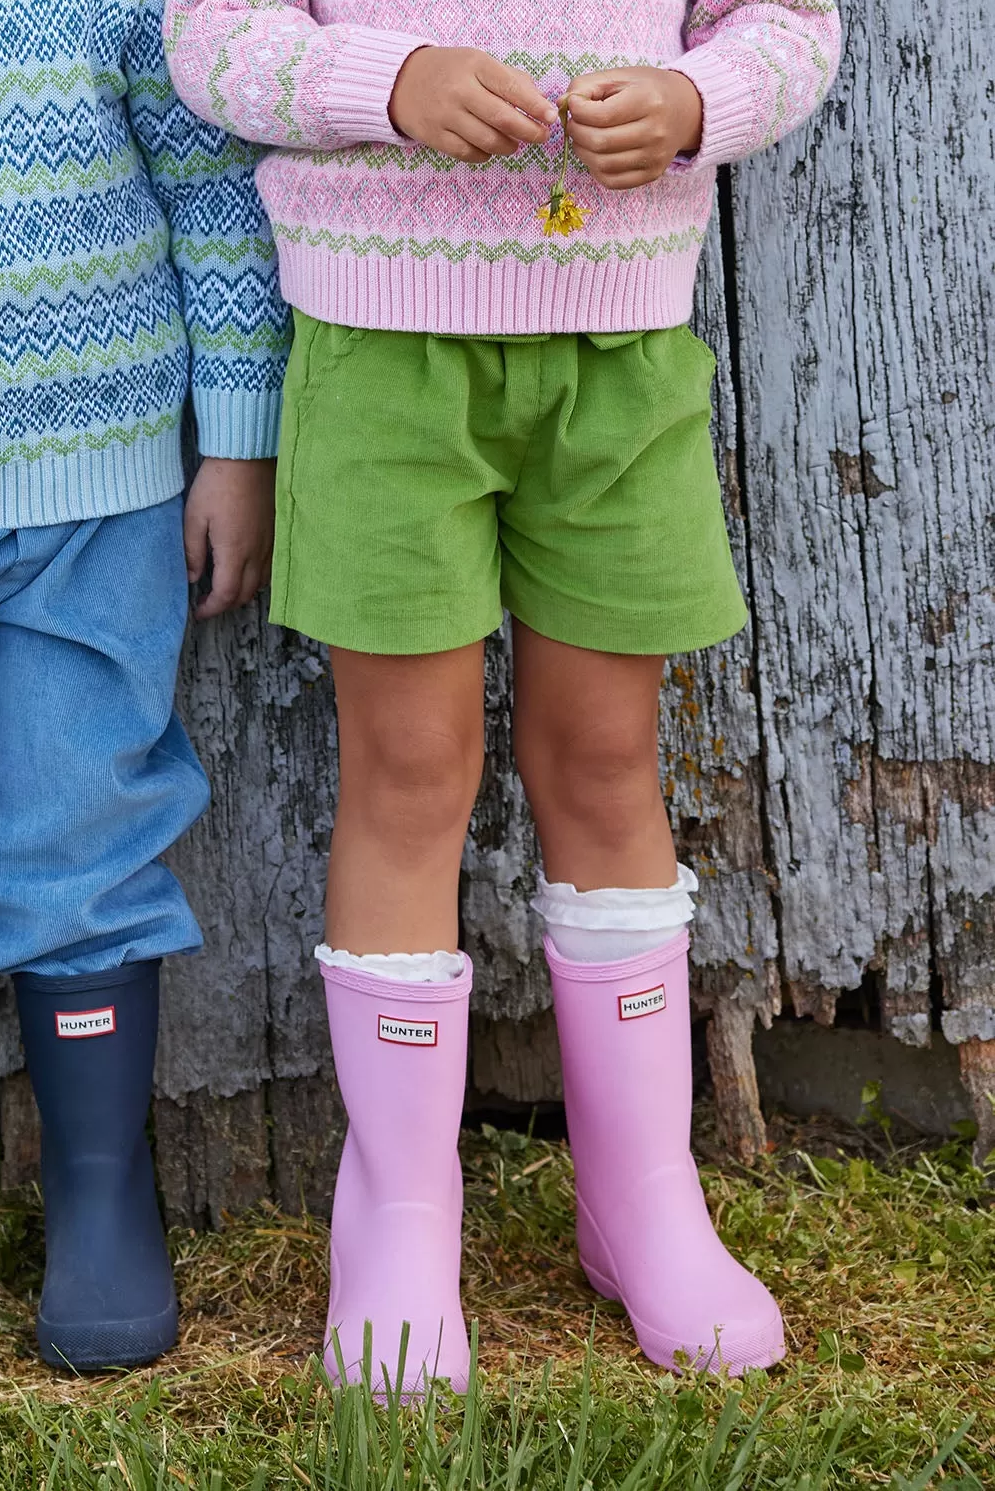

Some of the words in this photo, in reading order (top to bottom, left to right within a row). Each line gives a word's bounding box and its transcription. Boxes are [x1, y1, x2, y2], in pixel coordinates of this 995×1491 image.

[623, 994, 663, 1011] HUNTER
[60, 1017, 110, 1030] HUNTER
[381, 1024, 433, 1038] HUNTER
